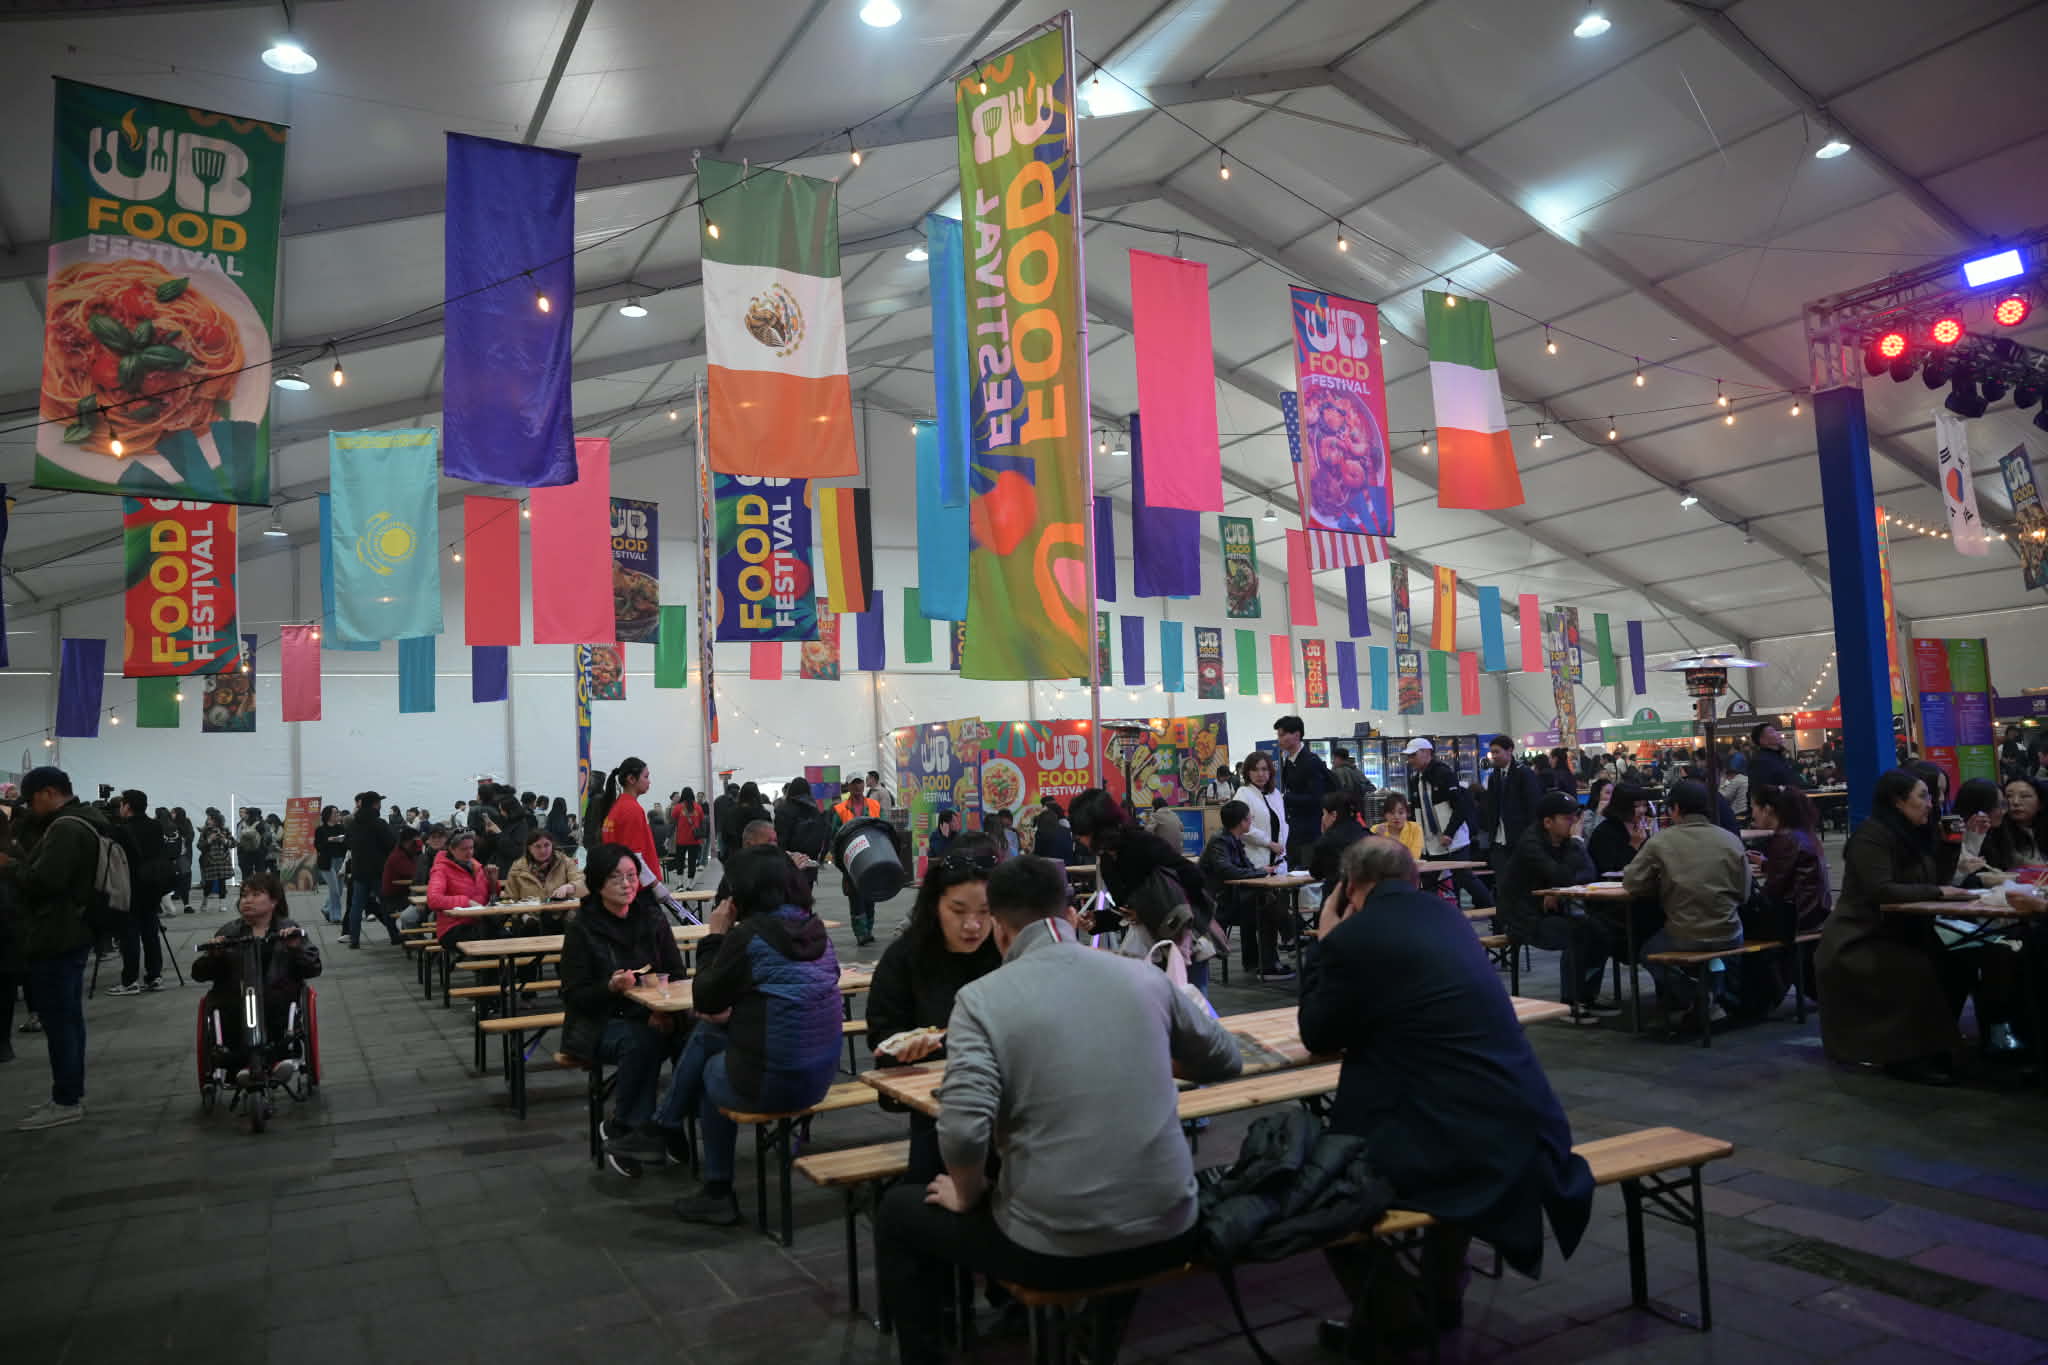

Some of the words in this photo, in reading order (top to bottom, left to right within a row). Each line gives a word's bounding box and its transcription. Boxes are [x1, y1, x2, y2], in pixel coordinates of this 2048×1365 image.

[87, 197, 248, 253] FOOD
[87, 232, 245, 278] FESTIVAL
[1308, 351, 1371, 381] FOOD
[1311, 373, 1371, 395] FESTIVAL
[611, 536, 649, 553] OOD
[611, 549, 648, 562] ESTIVAL
[1225, 543, 1252, 553] FOOD
[736, 494, 773, 630] FOOD
[771, 495, 796, 628] FESTIVAL
[149, 519, 190, 664] FOOD
[191, 519, 216, 662] FESTIVAL
[921, 774, 951, 791] FOOD
[1037, 770, 1089, 786] FOOD
